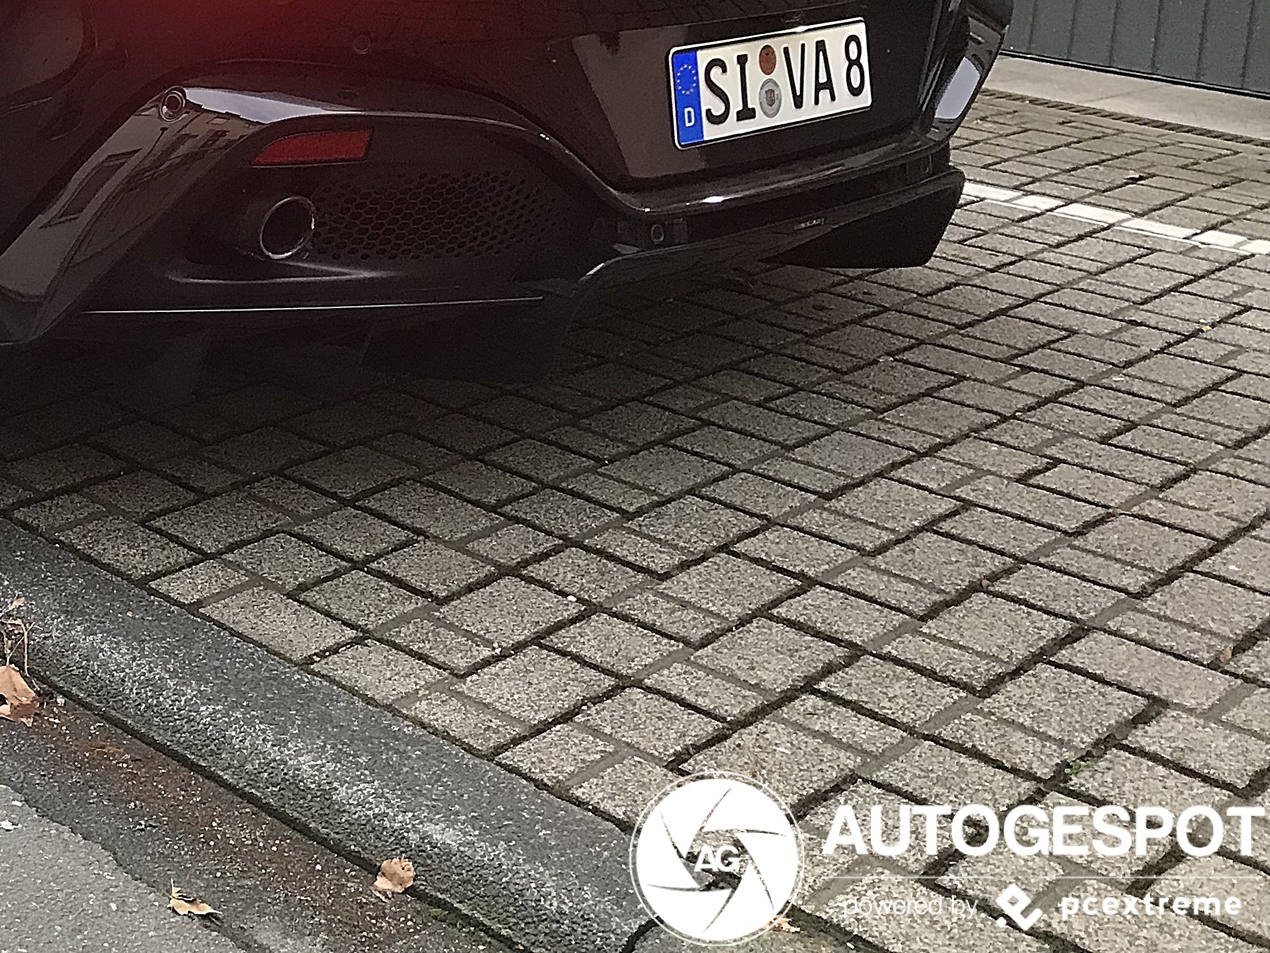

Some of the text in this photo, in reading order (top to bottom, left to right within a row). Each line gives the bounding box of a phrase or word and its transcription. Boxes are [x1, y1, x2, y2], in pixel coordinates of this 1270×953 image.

[704, 34, 865, 126] SI VA 8
[684, 107, 695, 128] D
